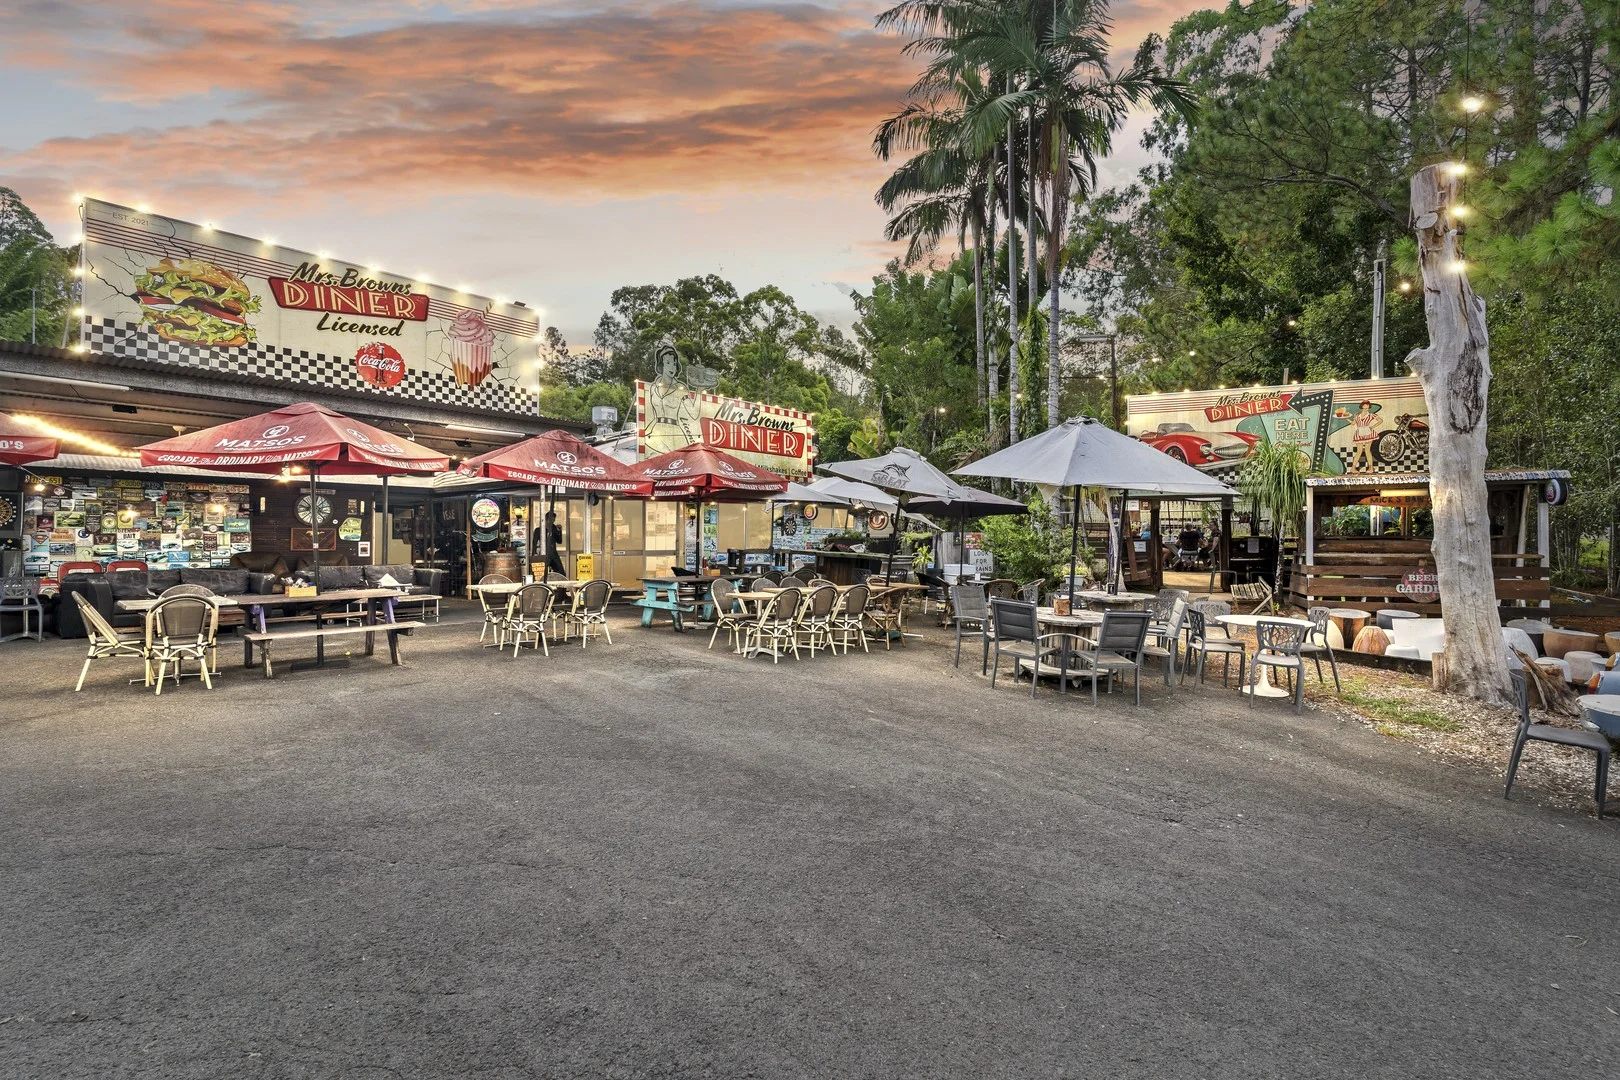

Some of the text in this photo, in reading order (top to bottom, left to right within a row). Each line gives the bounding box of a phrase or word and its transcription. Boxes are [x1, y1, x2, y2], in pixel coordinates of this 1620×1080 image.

[112, 212, 149, 226] EST. 2021
[283, 282, 415, 319] DINER
[316, 312, 405, 337] Licensed
[1211, 398, 1284, 421] DINER
[679, 417, 695, 444] Licens
[1274, 417, 1310, 431] EAT
[215, 435, 306, 447] MATSO'S
[709, 420, 799, 457] DINER
[1276, 431, 1309, 440] HERE
[157, 454, 199, 465] ESCAPE
[214, 455, 265, 466] ORDINARY
[533, 459, 606, 475] MATSO'S
[791, 468, 807, 477] Coffee
[507, 470, 537, 482] ESCAPE
[550, 477, 590, 489] ORDINARY
[605, 482, 637, 491] MATSO'S
[1395, 583, 1440, 594] GARDE
